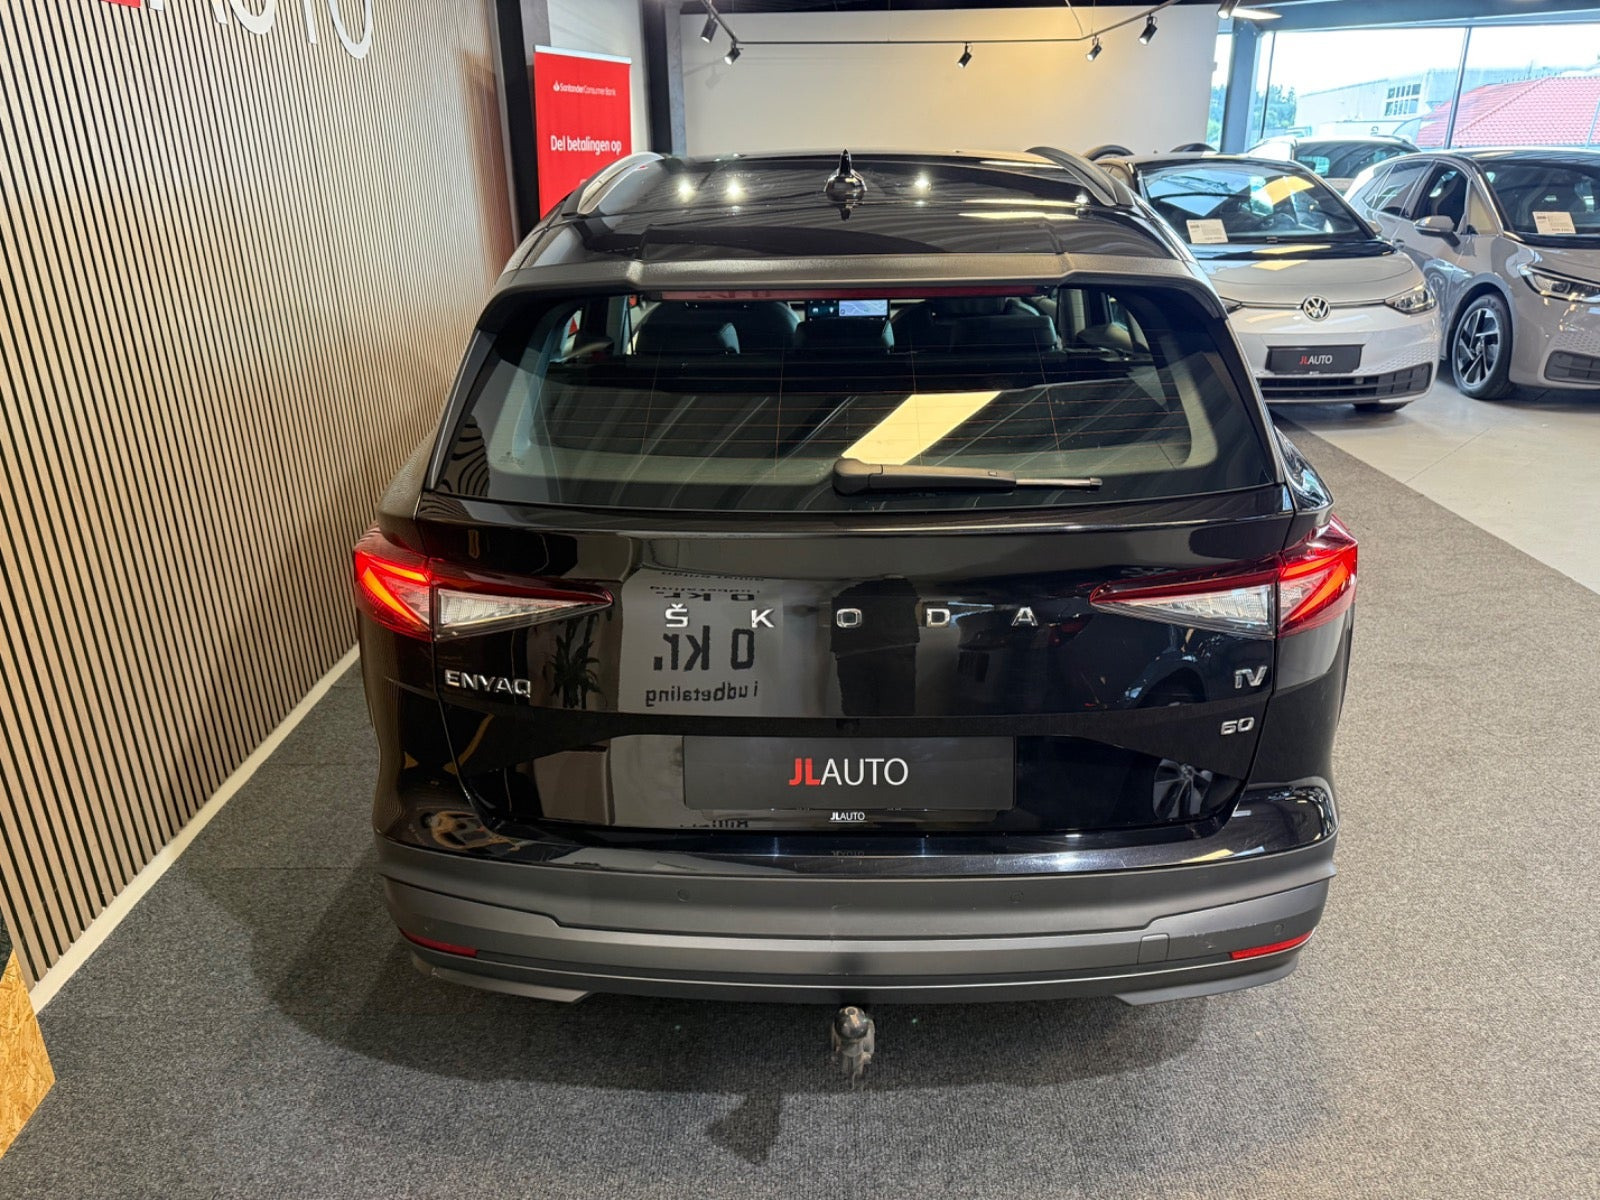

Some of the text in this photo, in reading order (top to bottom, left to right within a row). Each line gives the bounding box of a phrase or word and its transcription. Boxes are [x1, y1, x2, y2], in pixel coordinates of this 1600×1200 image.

[550, 135, 622, 156] Del betalingen op
[444, 669, 531, 698] ENYAQ
[1220, 717, 1255, 736] 60
[789, 758, 909, 786] JLAUTO
[830, 812, 866, 821] JLAUTO
